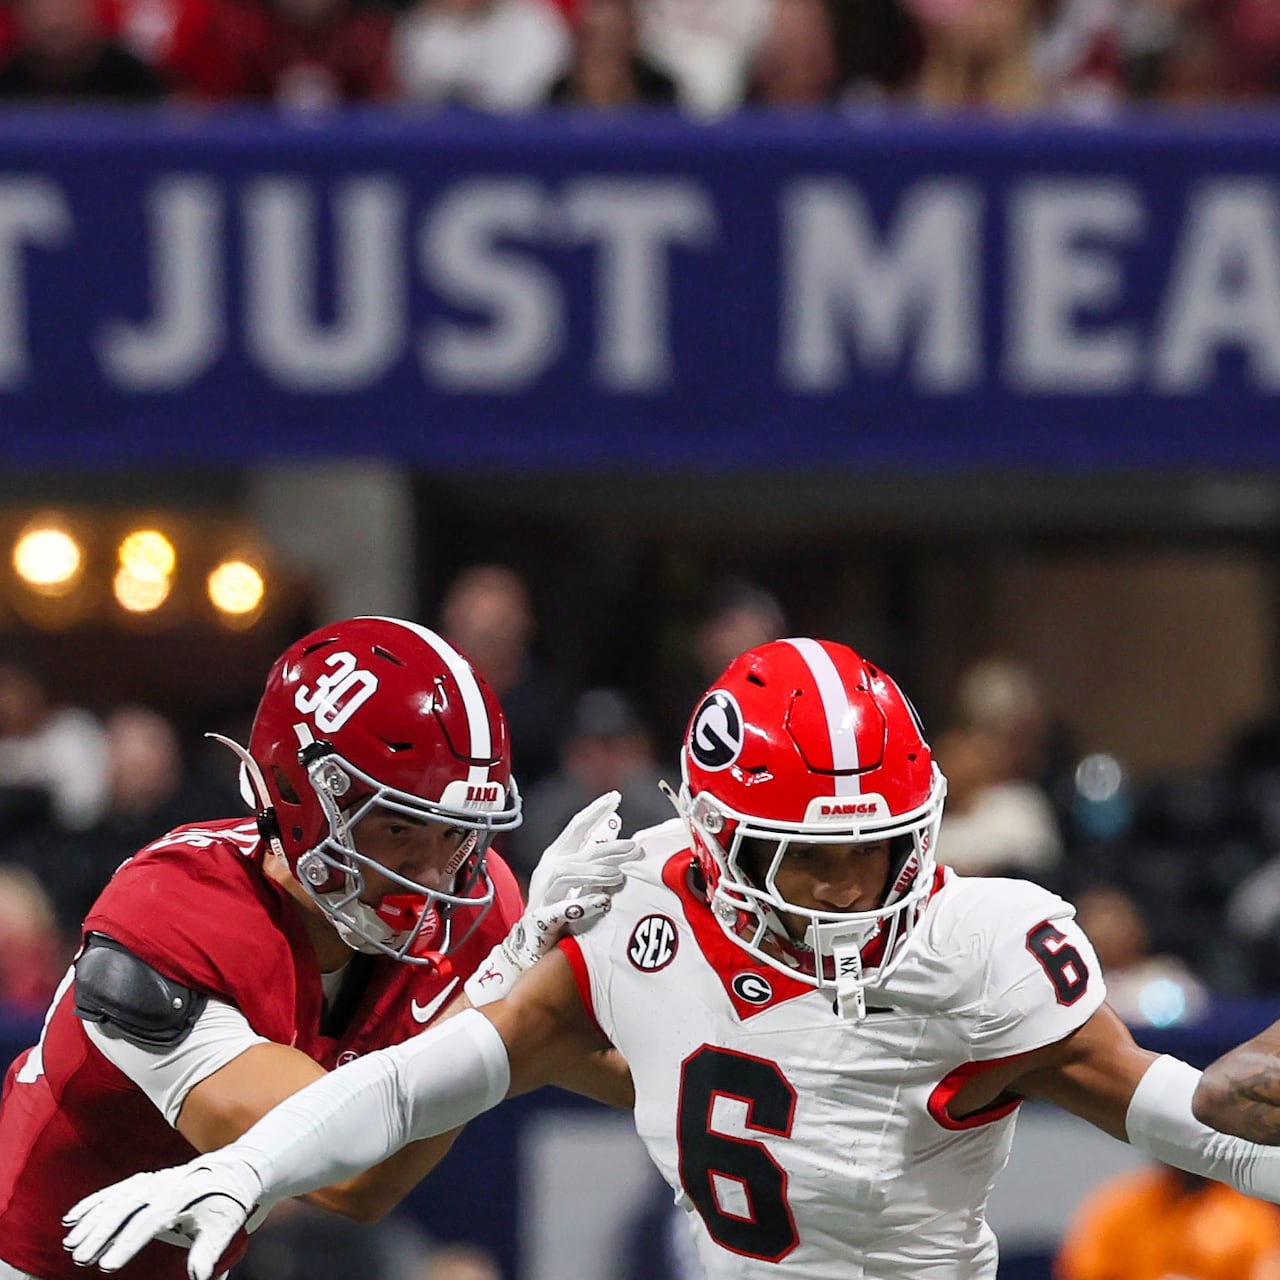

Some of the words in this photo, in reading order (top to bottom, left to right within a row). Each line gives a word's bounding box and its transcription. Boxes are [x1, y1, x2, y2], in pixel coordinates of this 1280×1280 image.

[102, 180, 710, 390] JUST
[294, 651, 379, 733] 30
[820, 802, 877, 816] DAWGS
[445, 835, 478, 874] CRIMSON
[630, 917, 675, 968] SEC
[1025, 920, 1089, 1007] 6
[733, 974, 771, 1003] G
[677, 1043, 800, 1263] 6
